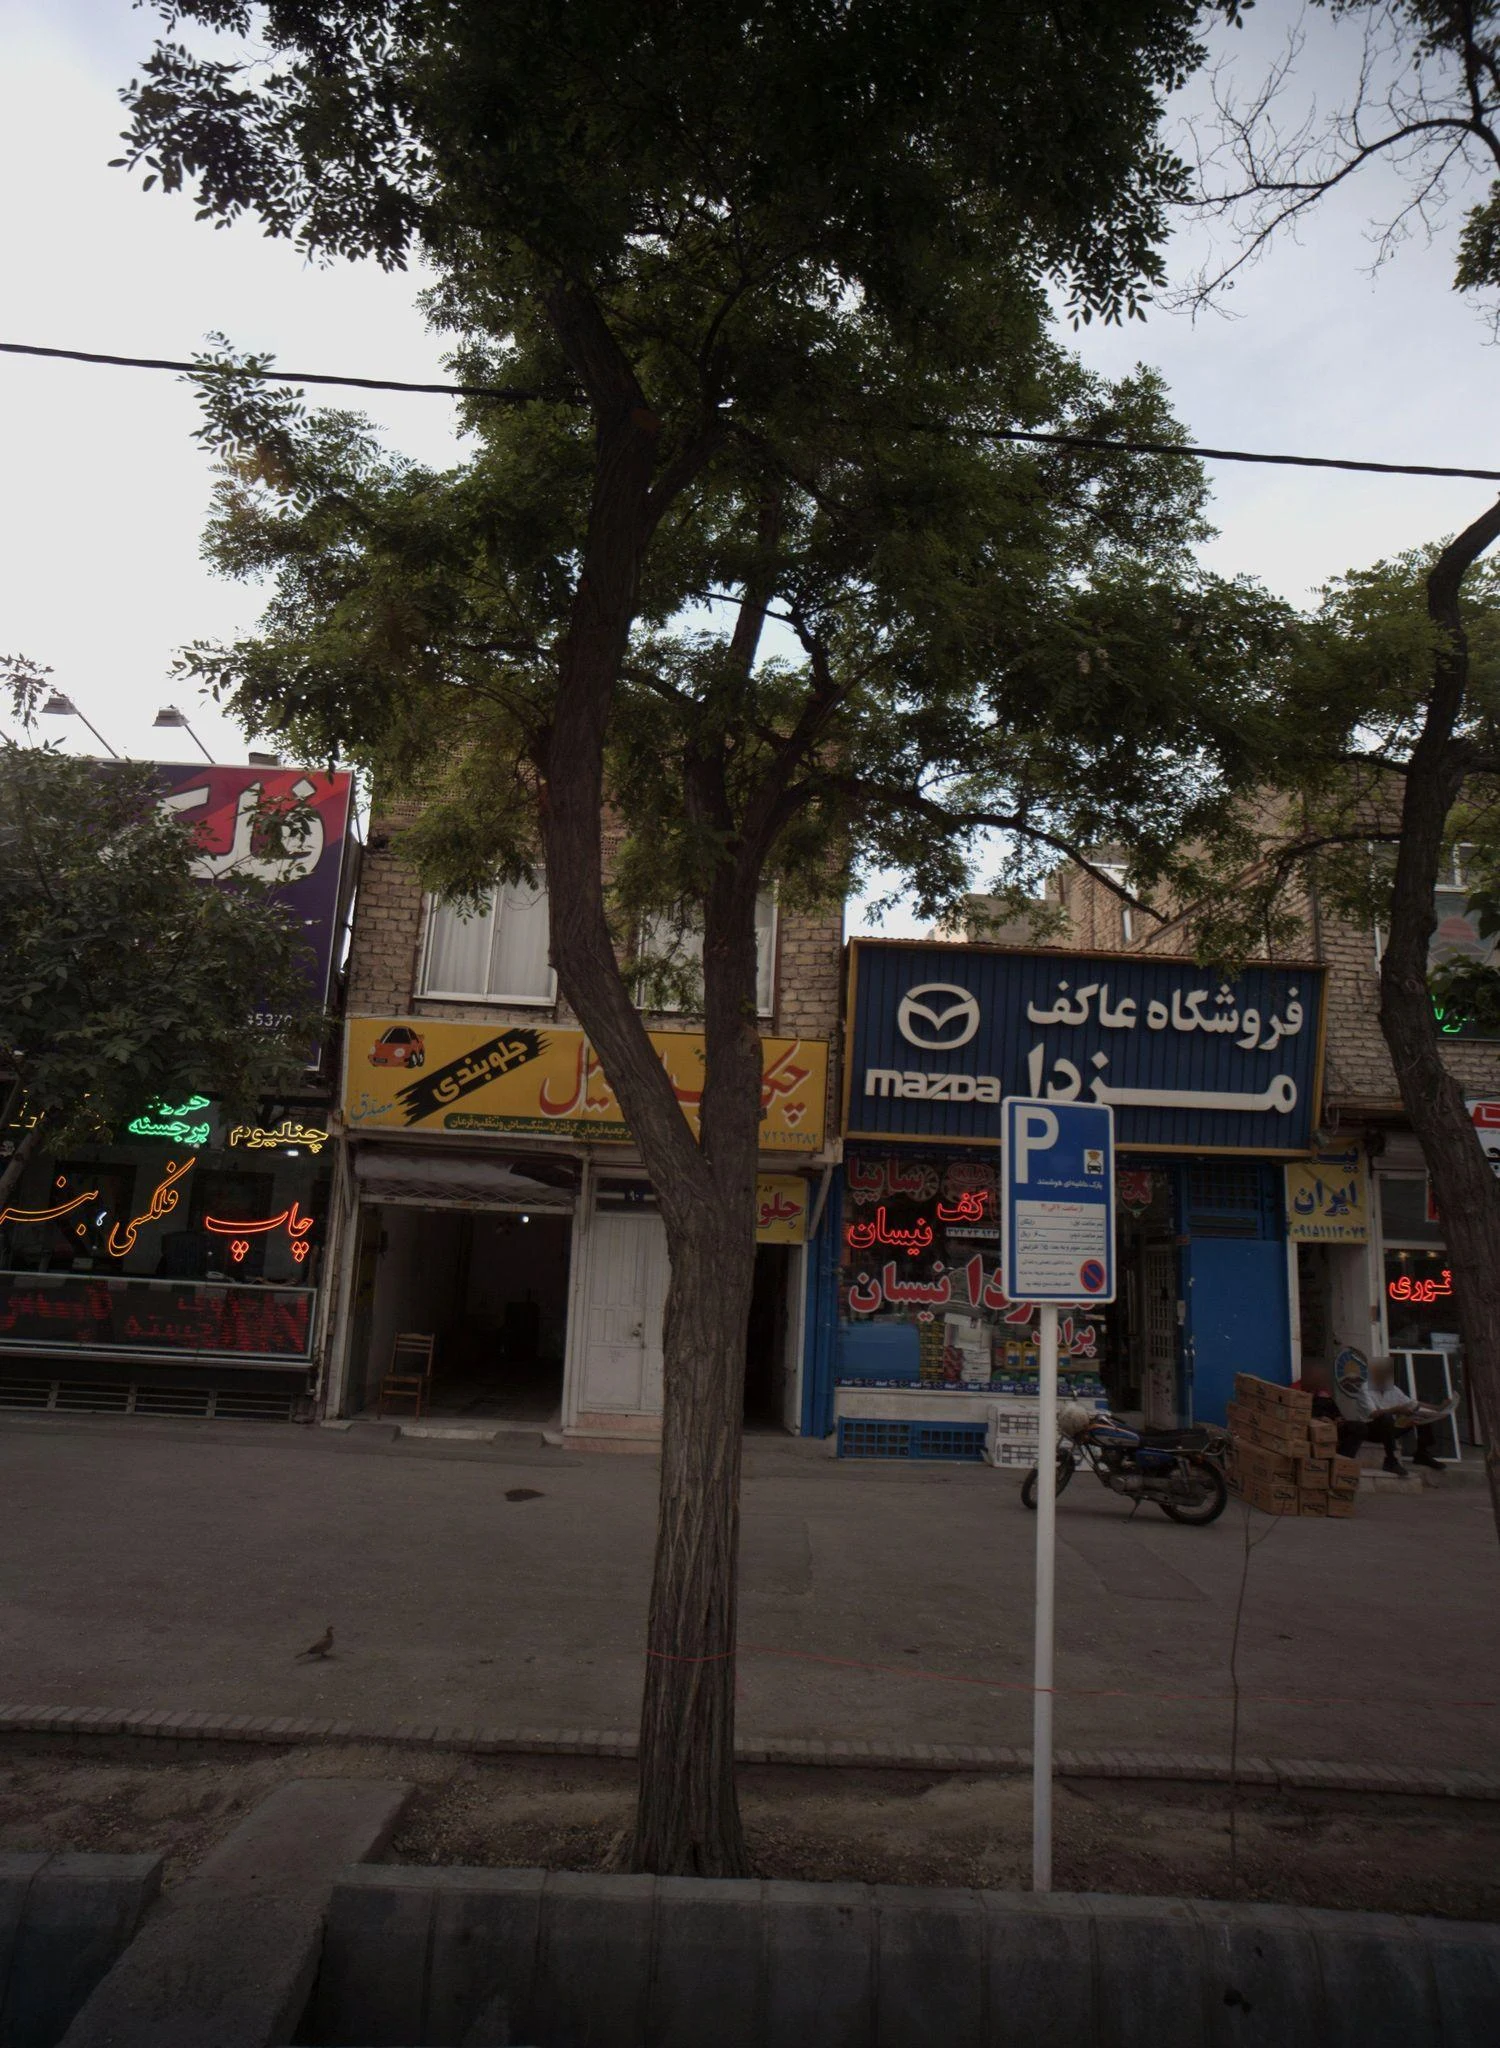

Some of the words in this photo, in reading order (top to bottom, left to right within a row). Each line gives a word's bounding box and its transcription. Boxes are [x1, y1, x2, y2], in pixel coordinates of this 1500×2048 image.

[1026, 979, 1138, 1030] عاکف
[1147, 982, 1304, 1051] فروشگاه
[432, 1040, 528, 1103] جلوبندی
[1026, 1041, 1299, 1115] مزدا
[1015, 1105, 1060, 1184] P
[1294, 1177, 1358, 1216] ایران
[204, 1199, 315, 1264] چاپ
[847, 1204, 934, 1257] نیسان
[849, 1260, 951, 1322] نیسان
